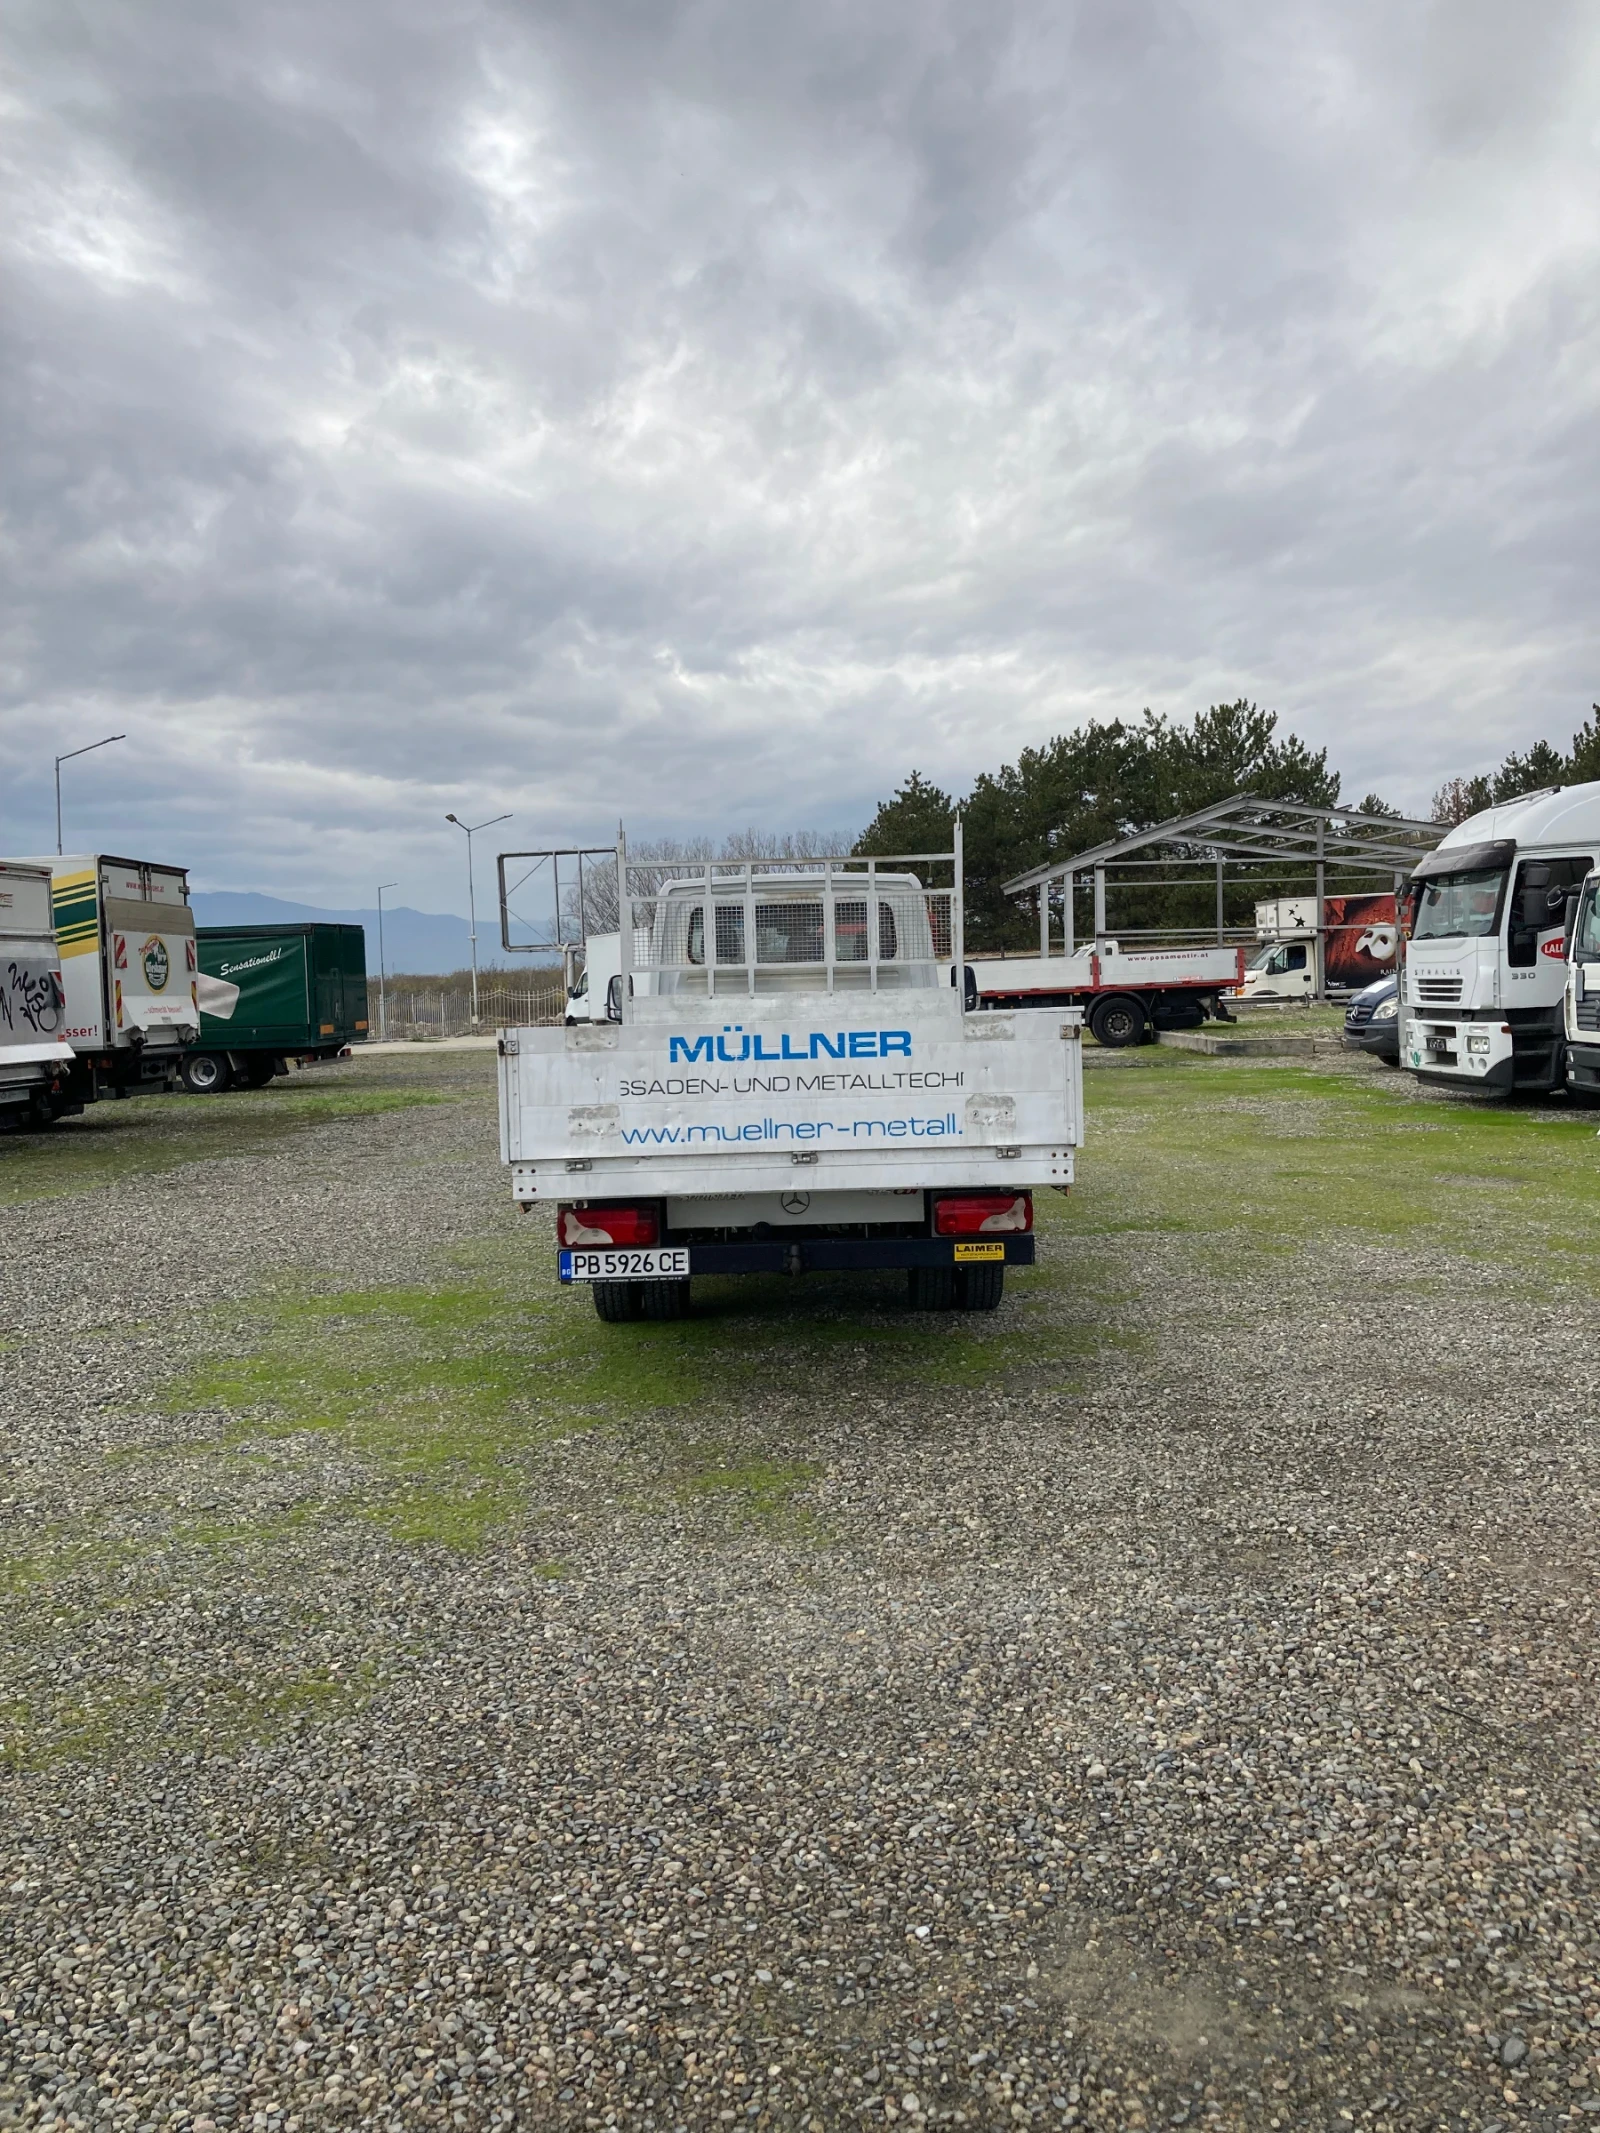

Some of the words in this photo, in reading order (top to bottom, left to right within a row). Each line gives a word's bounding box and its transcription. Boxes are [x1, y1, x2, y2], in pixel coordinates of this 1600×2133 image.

[220, 947, 282, 976] Sensationell!
[1127, 952, 1209, 962] www.posamentir.at
[1511, 972, 1536, 980] 330
[65, 1024, 98, 1038] sser!
[669, 1026, 912, 1063] MÜLLNER
[733, 1076, 790, 1093] UND
[621, 1112, 963, 1145] ww.muellner-metall.
[956, 1244, 1003, 1253] LAIMER
[573, 1254, 601, 1276] PB
[604, 1252, 655, 1274] 5926
[658, 1251, 686, 1273] CE
